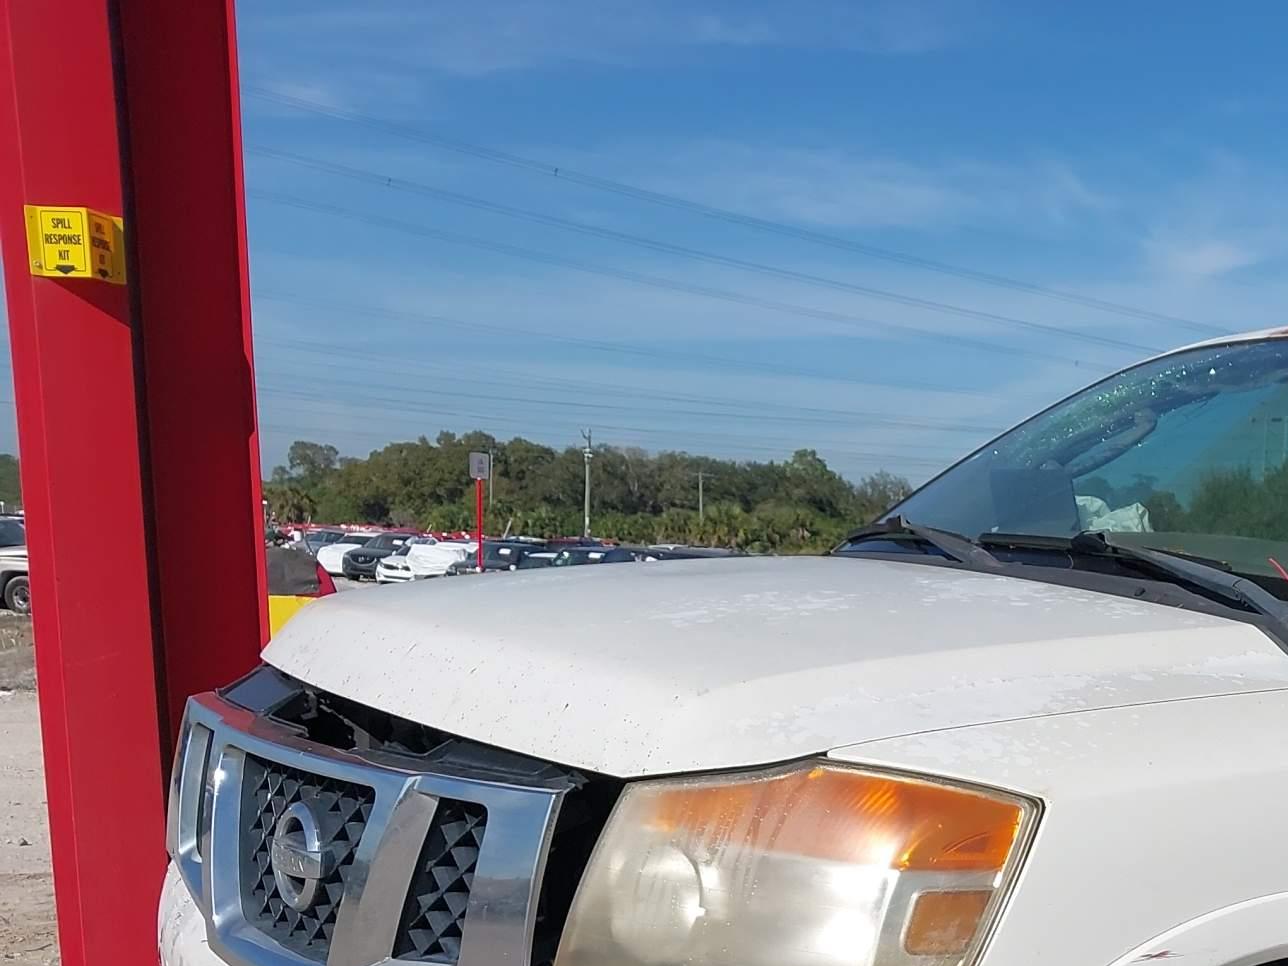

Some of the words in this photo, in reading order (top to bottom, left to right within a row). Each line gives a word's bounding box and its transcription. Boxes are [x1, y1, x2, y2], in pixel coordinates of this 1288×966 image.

[51, 217, 72, 229] SPILL
[44, 233, 82, 245] RESPONSE
[58, 249, 70, 261] KIT
